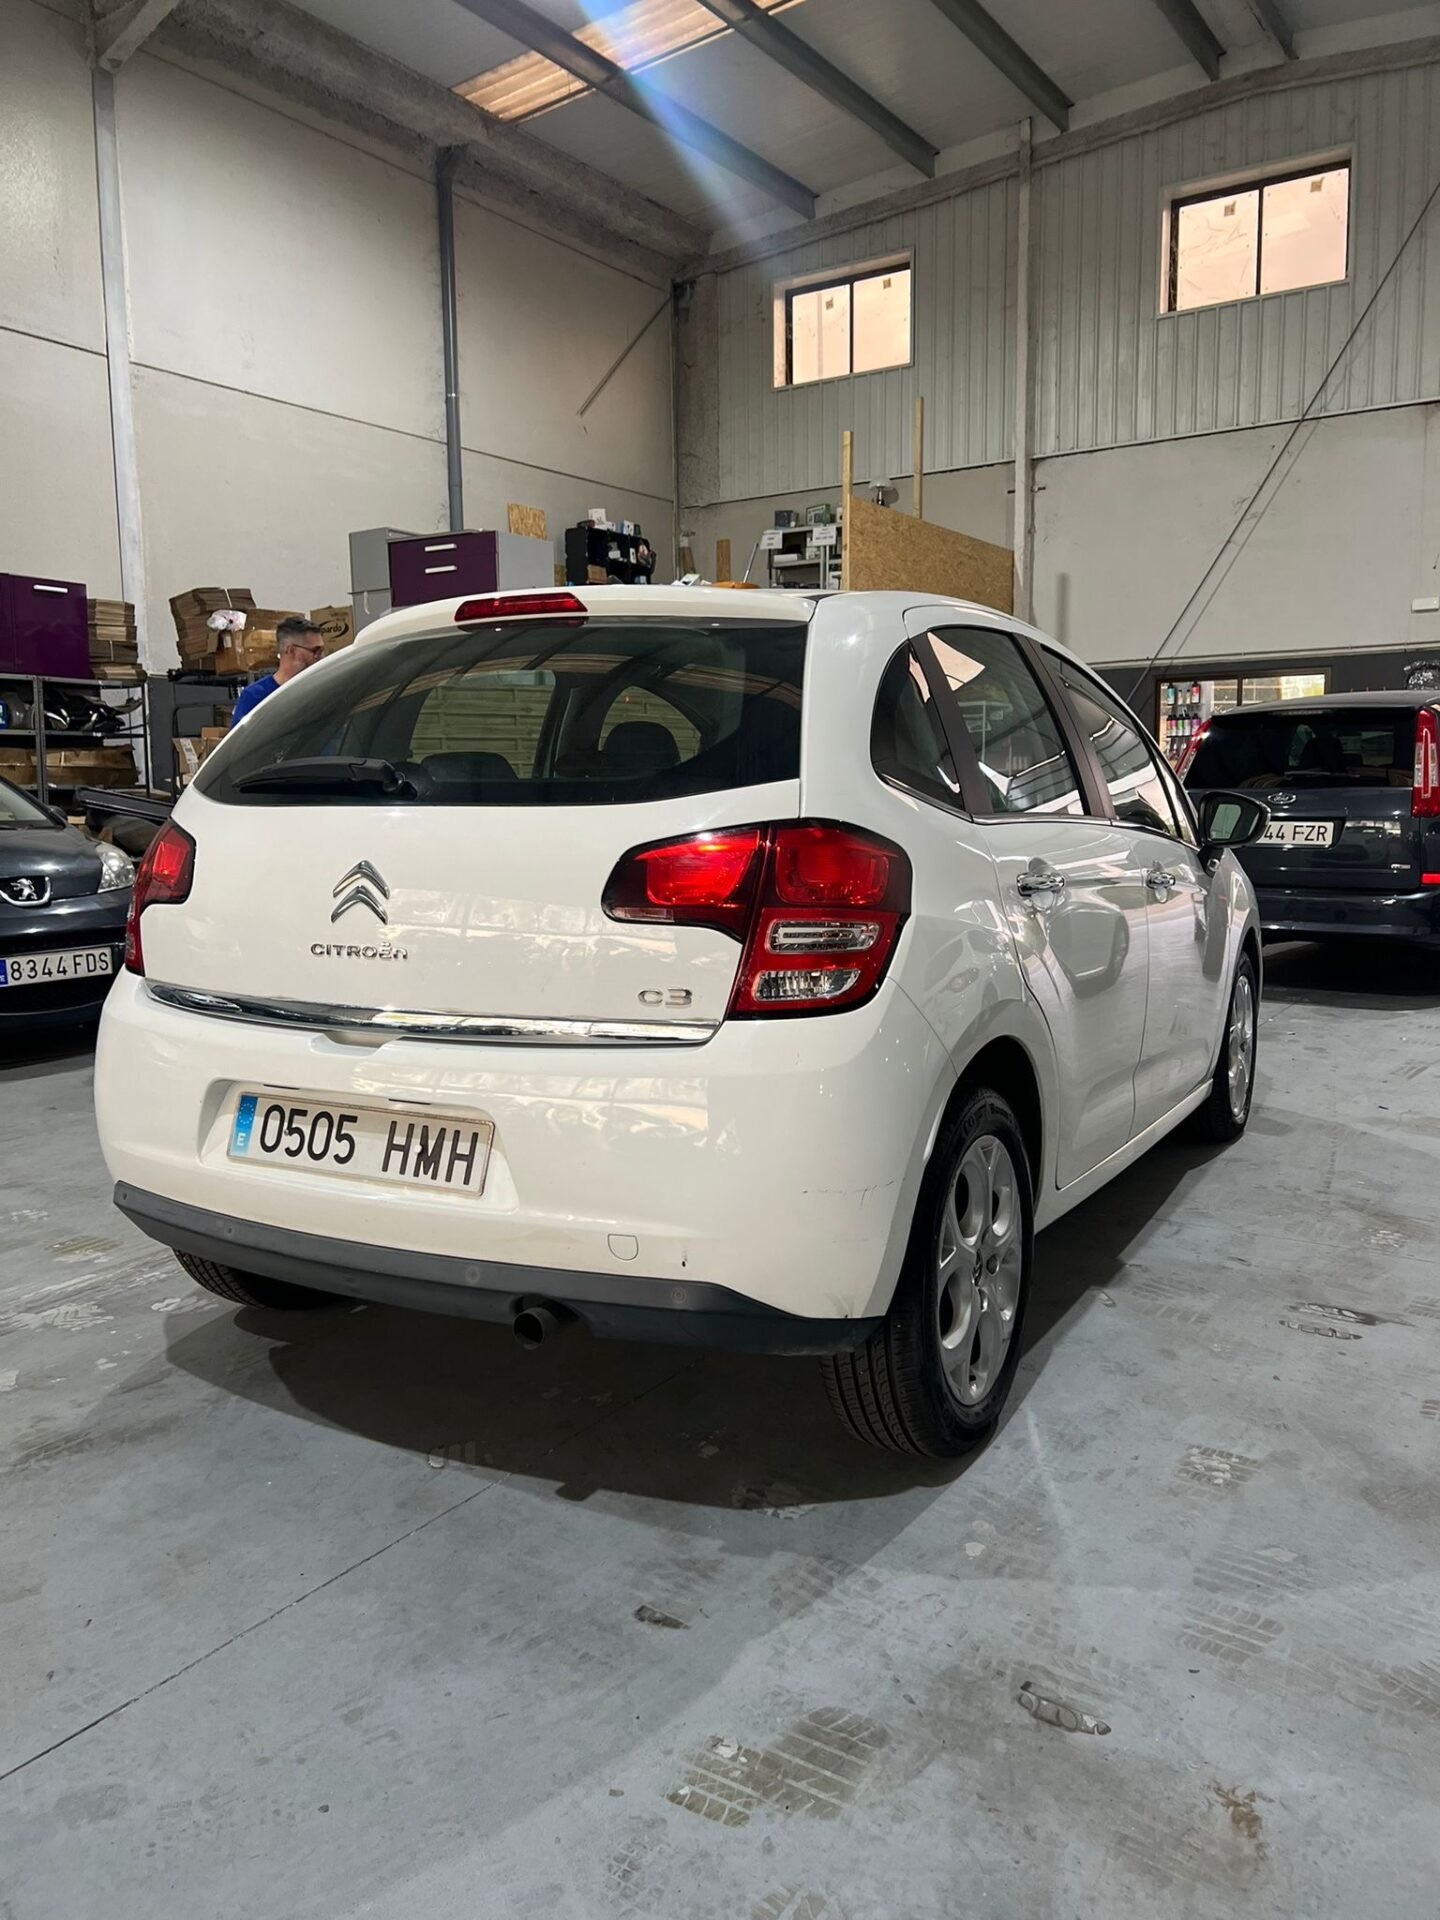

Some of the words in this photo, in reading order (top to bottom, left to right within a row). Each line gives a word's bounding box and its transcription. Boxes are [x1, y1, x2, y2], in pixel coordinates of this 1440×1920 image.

[1264, 825, 1286, 841] 44
[1292, 825, 1328, 841] FZR
[10, 956, 68, 981] 8344
[73, 952, 109, 975] FDS
[638, 988, 693, 1008] C3
[236, 1133, 245, 1146] E
[260, 1104, 358, 1165] 0505
[381, 1120, 479, 1186] HMH
